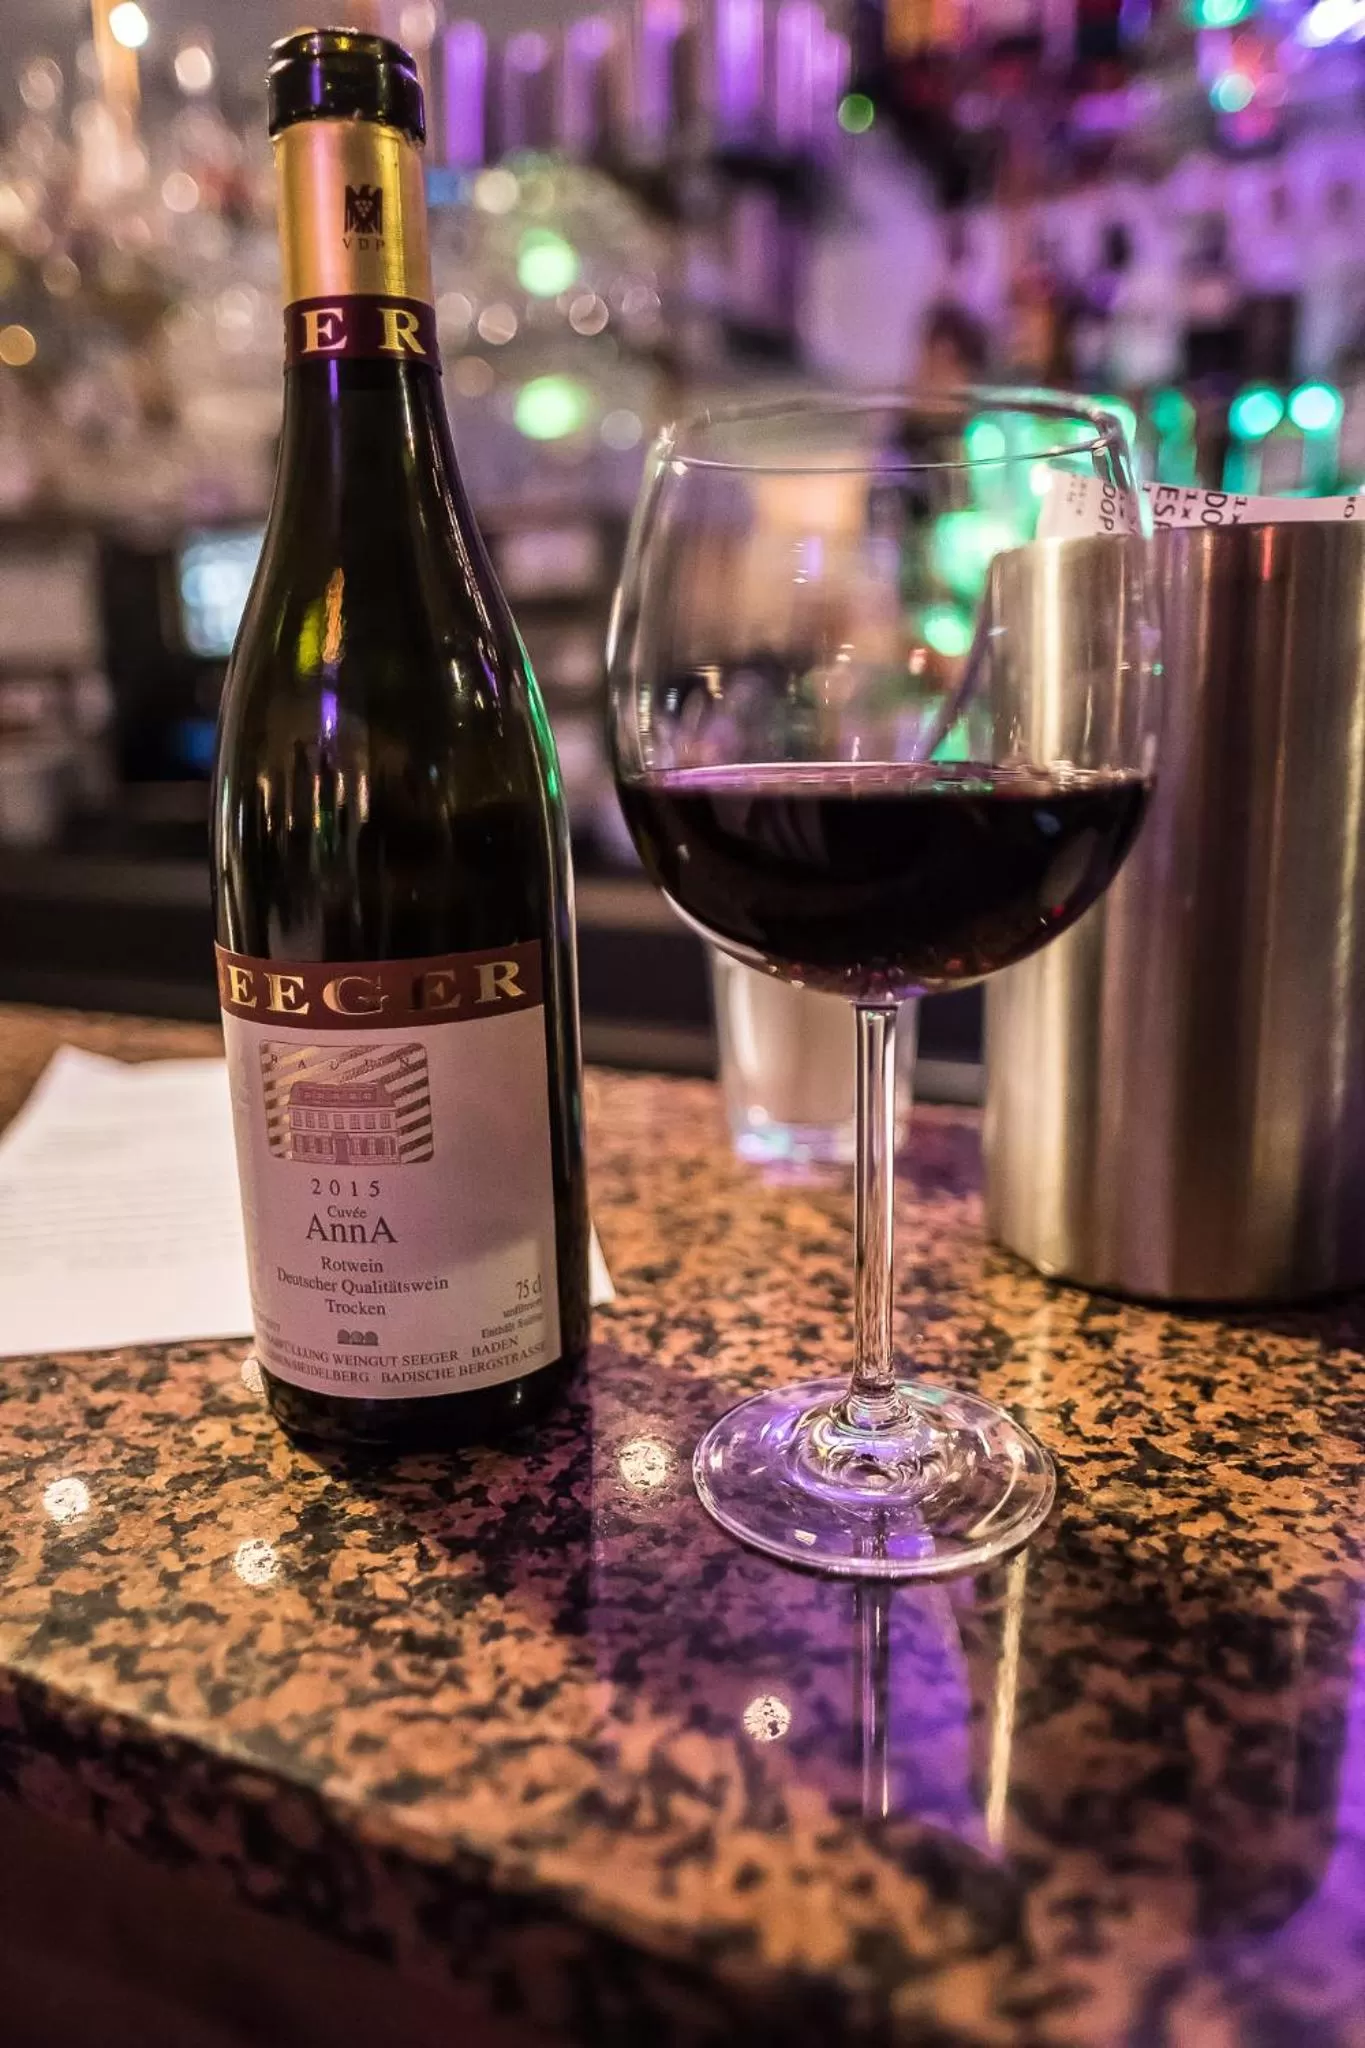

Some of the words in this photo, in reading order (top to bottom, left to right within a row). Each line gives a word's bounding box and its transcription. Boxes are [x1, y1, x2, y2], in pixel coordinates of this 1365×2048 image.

[342, 237, 385, 251] VDP
[219, 960, 527, 1016] EEGER
[311, 1178, 381, 1198] 2015
[327, 1205, 368, 1219] Cuvée
[306, 1213, 398, 1244] AnnA
[321, 1256, 384, 1273] Rotwein
[277, 1267, 337, 1293] Deutscher
[342, 1276, 449, 1296] Qualitätswein
[516, 1279, 529, 1300] 75
[325, 1299, 386, 1316] Trocken
[333, 1353, 398, 1367] WEINGUT
[402, 1351, 459, 1367] SEEGER
[472, 1335, 519, 1358] BADEN
[381, 1368, 456, 1384] BADISCHE
